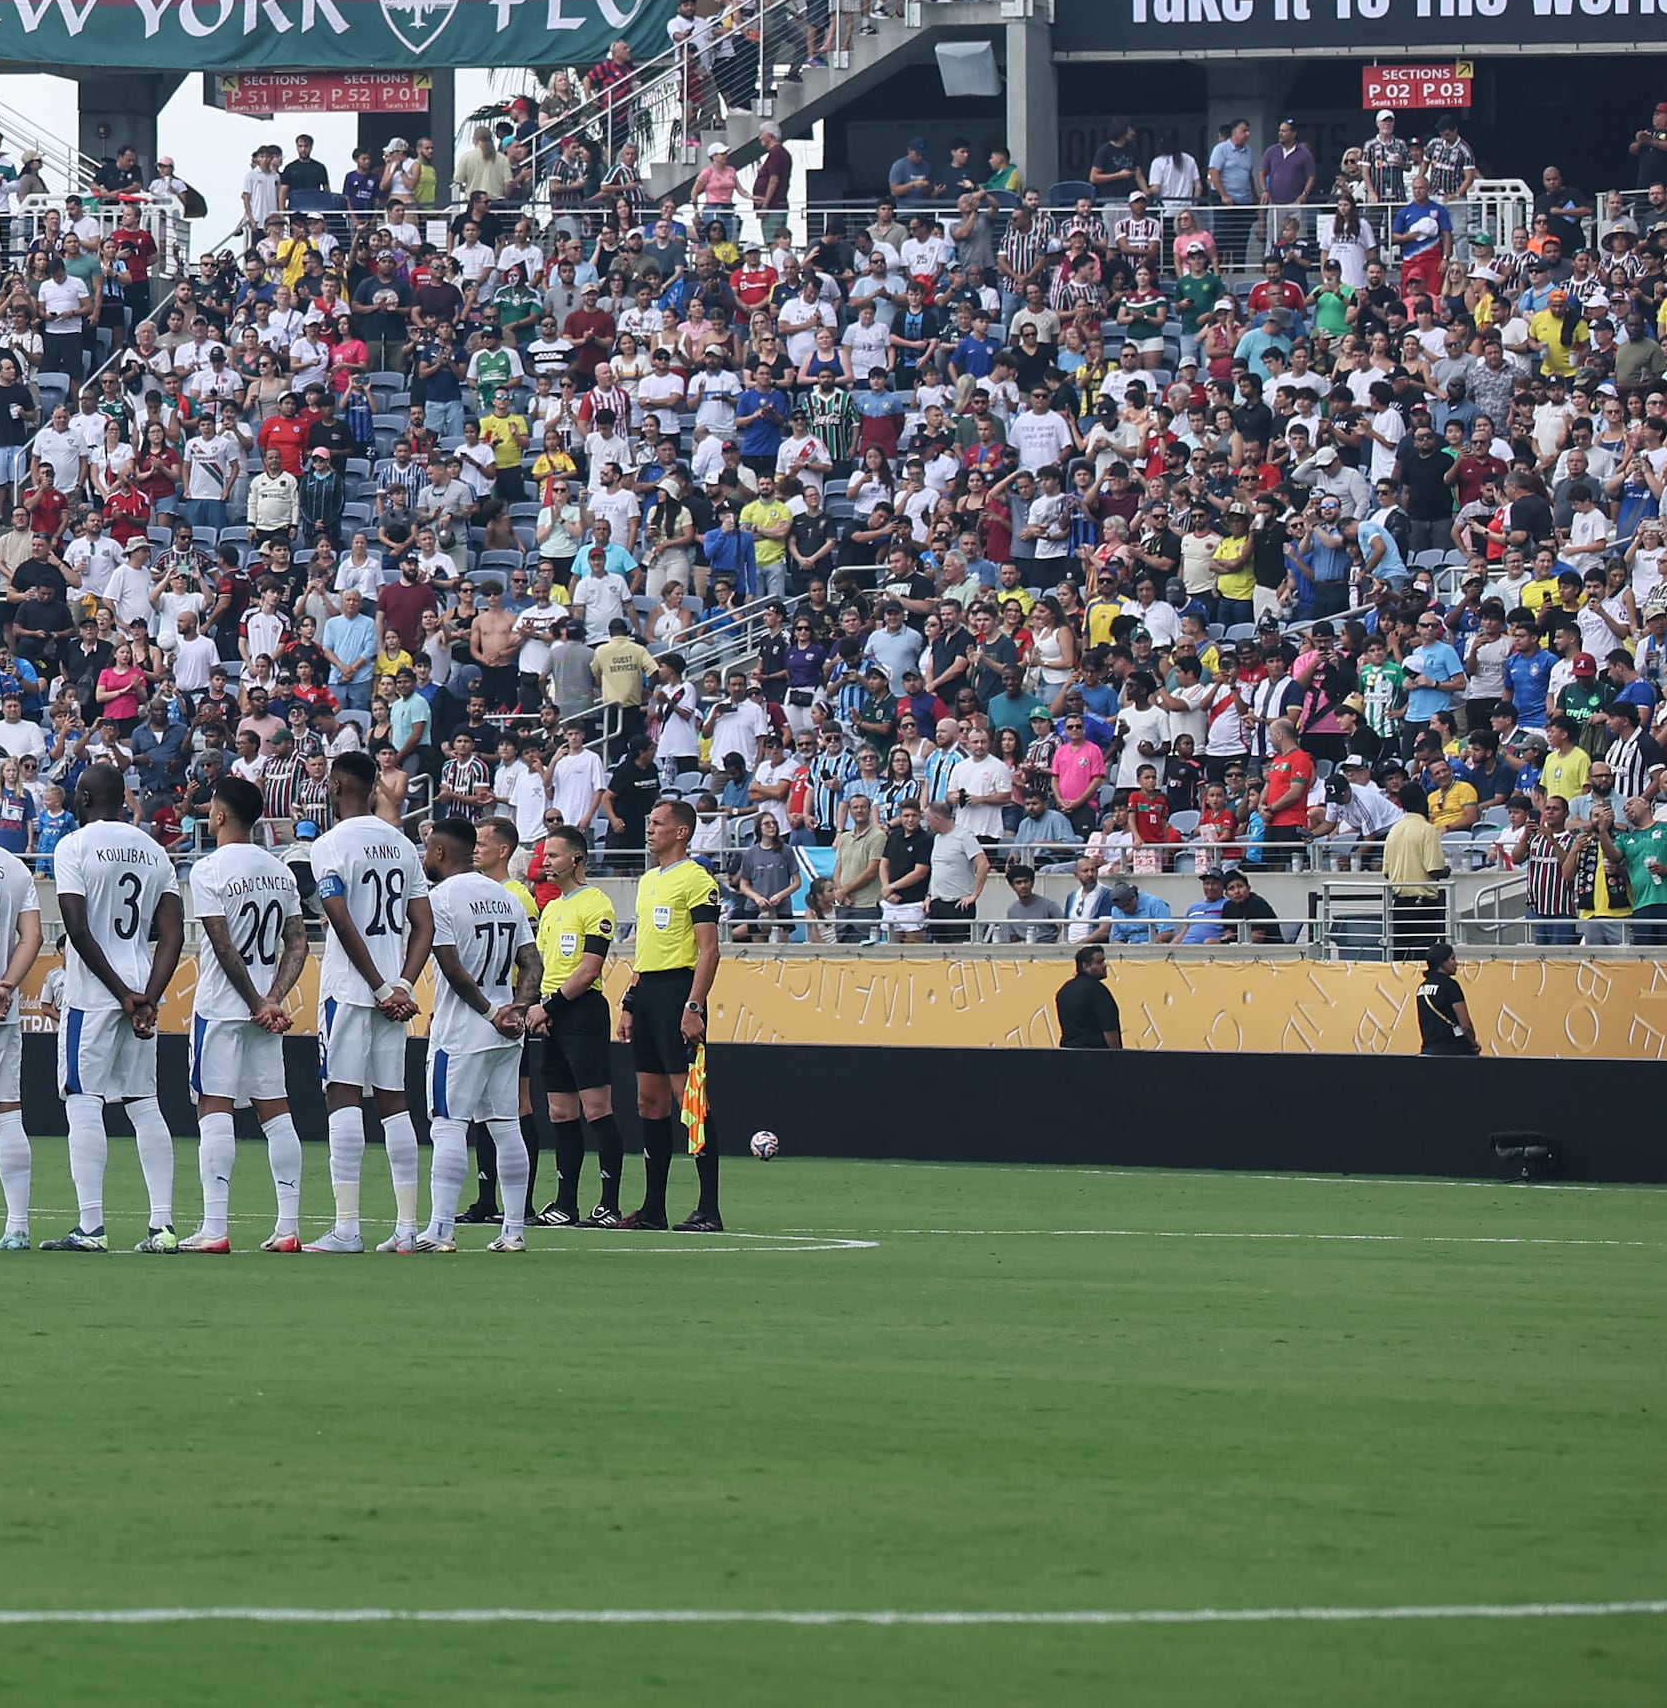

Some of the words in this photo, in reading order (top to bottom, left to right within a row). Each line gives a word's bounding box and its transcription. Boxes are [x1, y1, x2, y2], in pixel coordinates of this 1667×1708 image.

[243, 75, 308, 86] SECTIONS
[344, 74, 409, 85] SECTIONS
[1382, 68, 1451, 81] SECTIONS
[231, 89, 242, 103] P
[247, 88, 268, 102] 51
[282, 89, 293, 103] P
[299, 88, 322, 102] 52
[330, 88, 342, 102] P
[347, 88, 371, 101] 52
[382, 88, 394, 101] P
[398, 87, 421, 101] 01
[1368, 84, 1381, 98] P
[1385, 83, 1410, 98] 02
[1423, 83, 1435, 97] P
[1439, 82, 1465, 97] 03
[1370, 98, 1392, 107] Seats
[1424, 98, 1445, 106] Seats
[611, 655, 633, 665] GUEST
[609, 664, 639, 673] SERVICES
[96, 848, 159, 868] KOULIBALY
[363, 844, 401, 861] KANNO
[226, 874, 255, 898] JOÃO
[114, 872, 142, 940] 3
[361, 867, 405, 937] 28
[469, 900, 514, 916] MALCOM
[239, 899, 284, 966] 20
[561, 934, 575, 942] FIFA
[475, 921, 518, 987] 77
